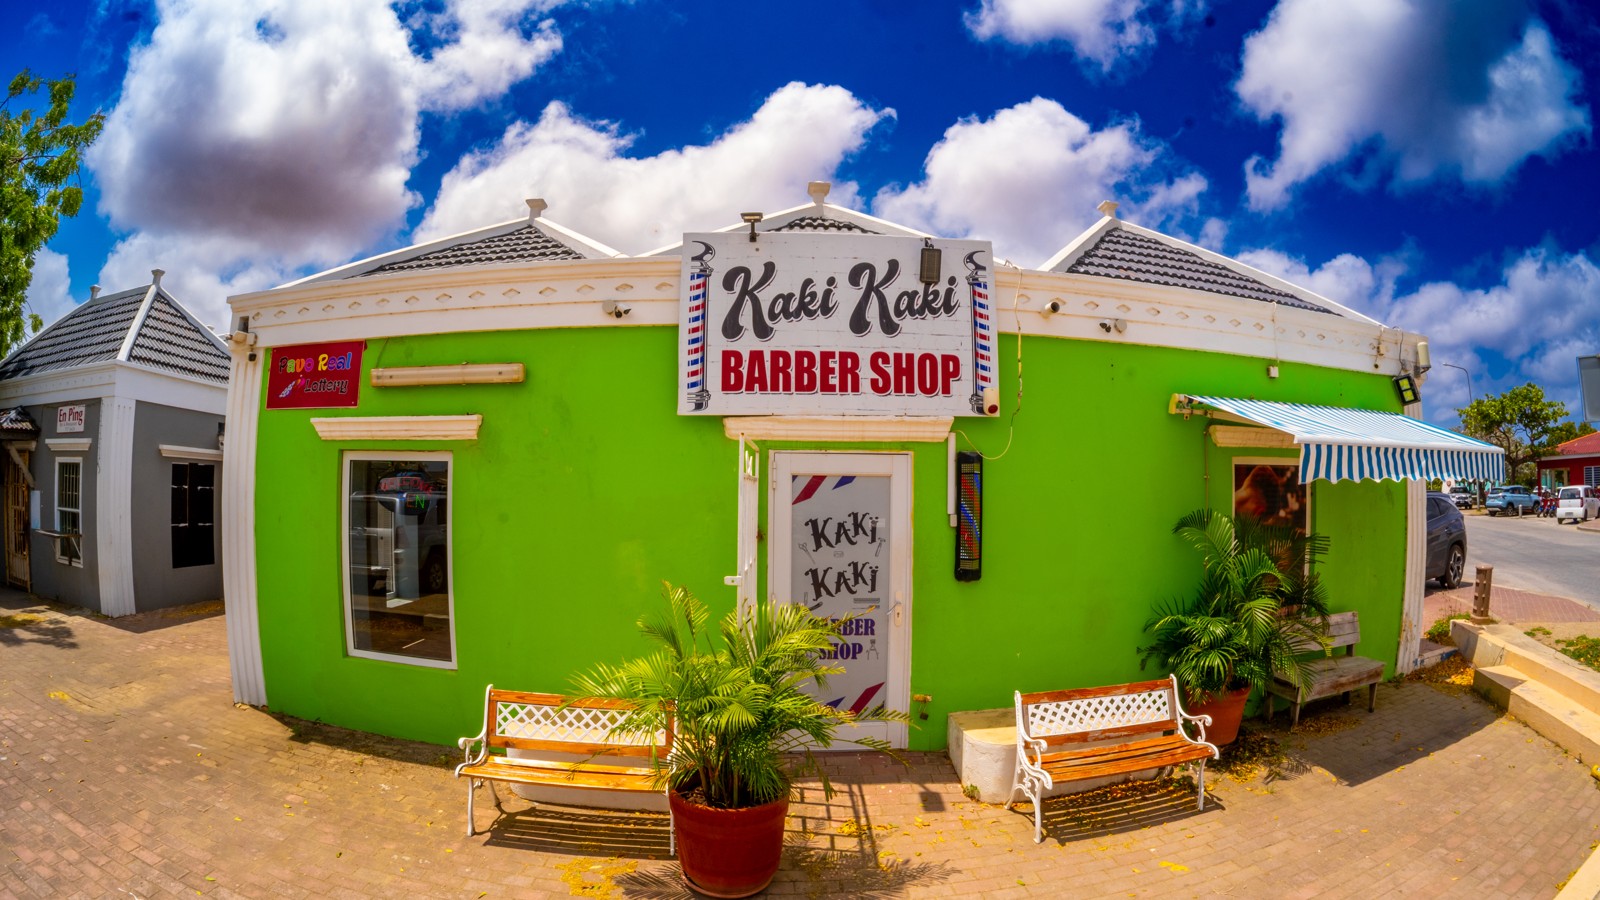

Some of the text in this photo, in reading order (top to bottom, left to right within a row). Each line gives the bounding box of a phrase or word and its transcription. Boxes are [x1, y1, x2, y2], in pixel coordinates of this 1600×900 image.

[721, 258, 963, 342] Kaki Kaki
[279, 352, 352, 373] Pavo Real
[720, 349, 963, 397] BARBER SHOP
[304, 378, 349, 395] Lottery
[58, 406, 83, 426] En Ping
